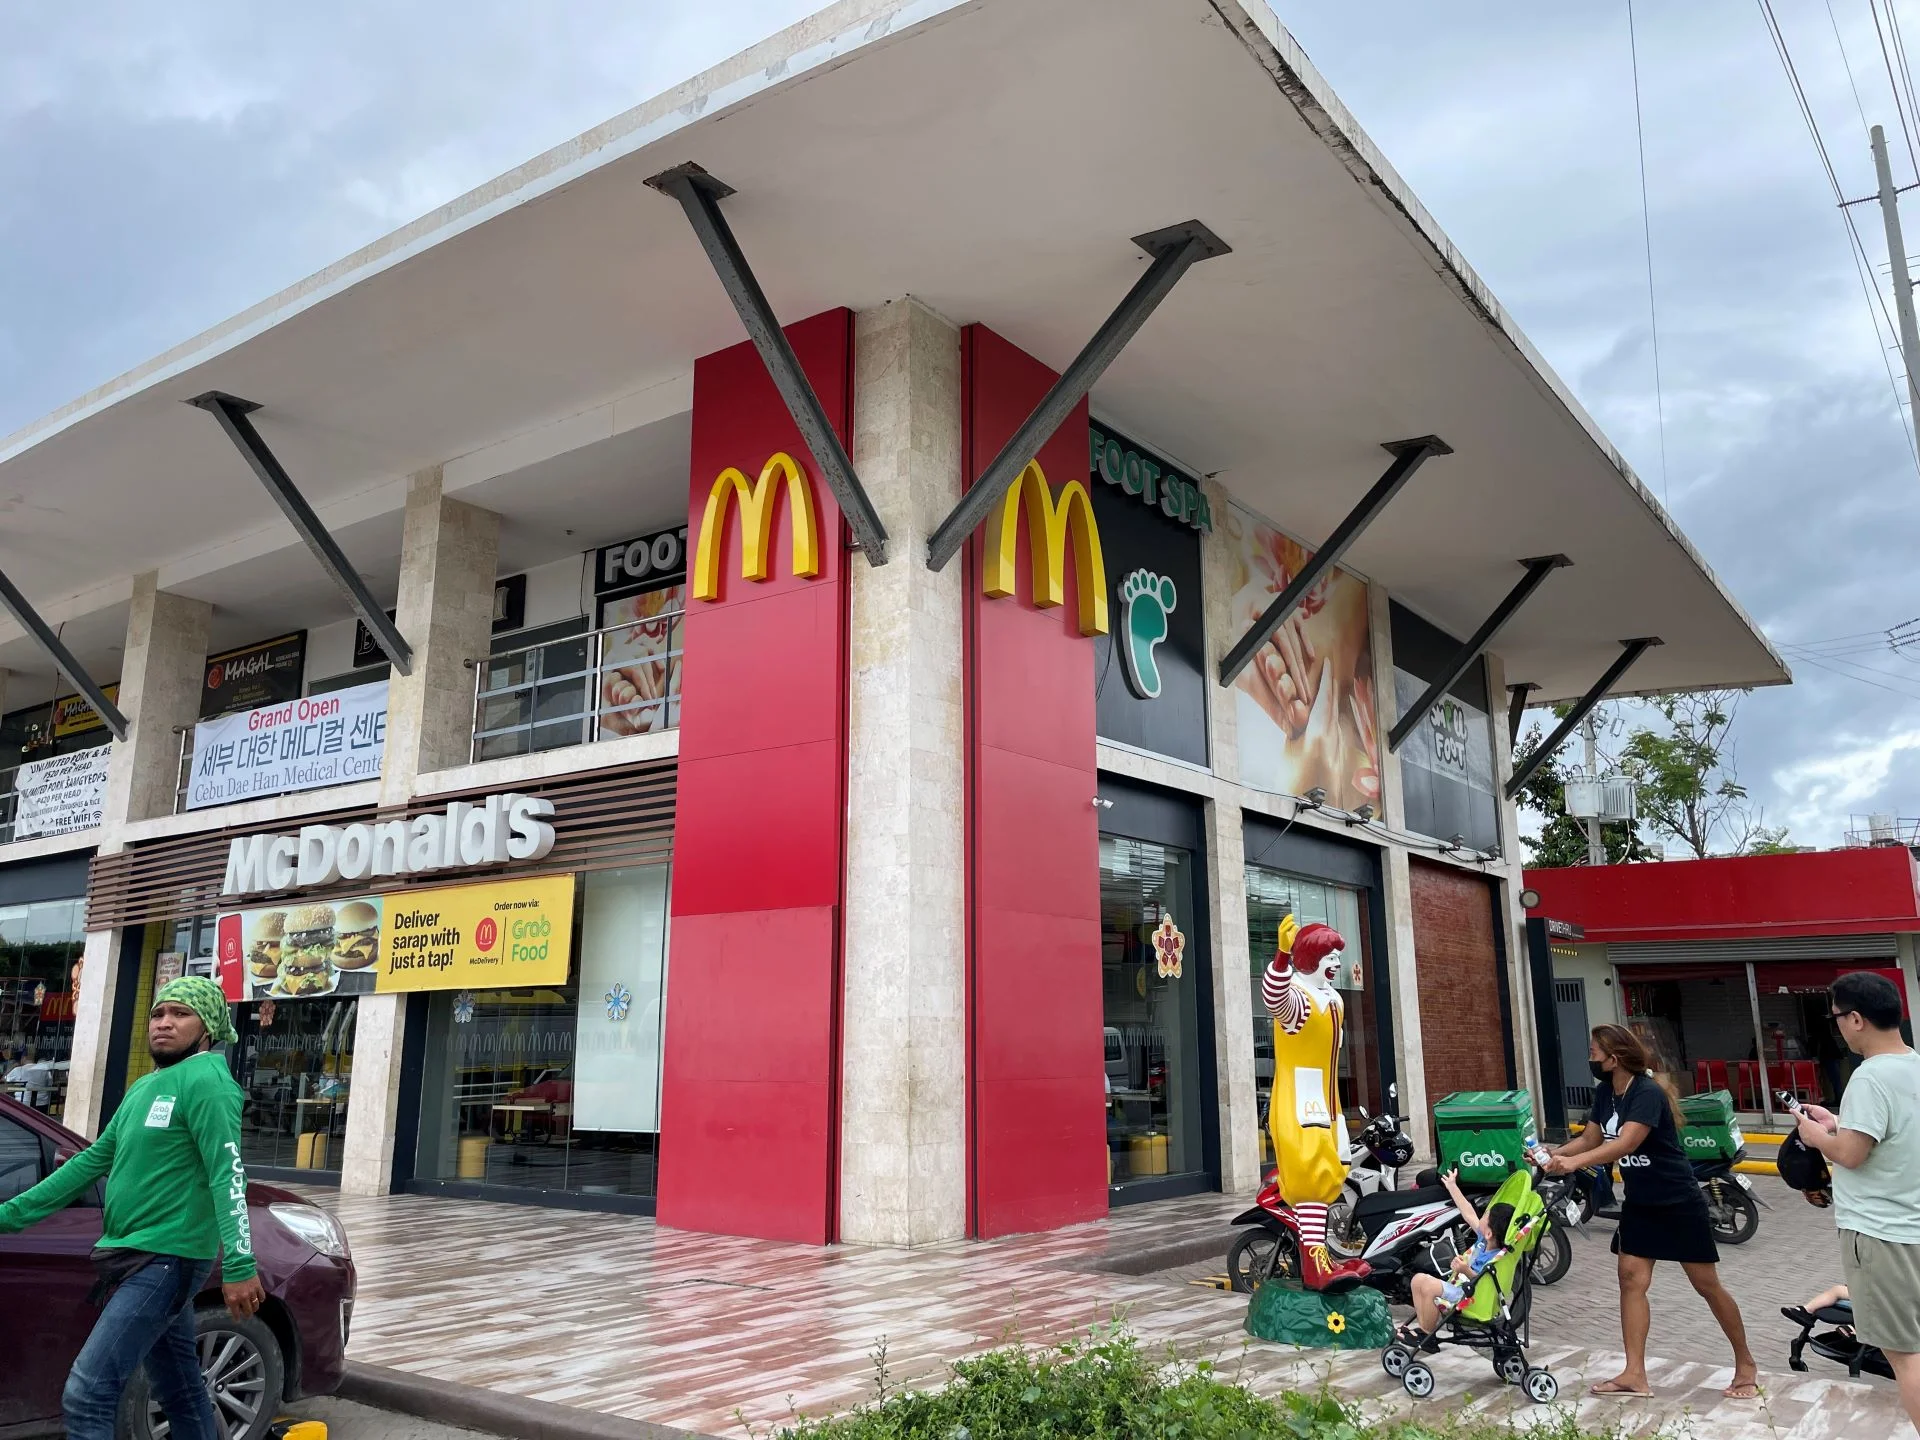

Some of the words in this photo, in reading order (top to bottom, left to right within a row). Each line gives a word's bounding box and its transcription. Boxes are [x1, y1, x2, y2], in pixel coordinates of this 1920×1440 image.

[1089, 427, 1160, 505] FOOT
[1161, 474, 1213, 536] SPA
[225, 651, 275, 680] MAGAL
[248, 703, 293, 732] Grand
[297, 698, 340, 724] Open
[199, 740, 235, 777] 세부
[237, 731, 277, 769] 대한
[280, 717, 345, 761] 메디컬
[1434, 729, 1465, 770] FOOT
[30, 756, 70, 774] UNLIMITED
[70, 752, 90, 764] PORK
[195, 783, 223, 802] Cebu
[227, 778, 249, 796] Dae
[252, 771, 279, 792] Han
[283, 758, 338, 786] Medical
[343, 753, 383, 777] Cente
[55, 817, 71, 827] FREE
[73, 813, 91, 824] WIFI
[222, 792, 556, 896] McDonald's
[494, 901, 513, 911] Order
[513, 902, 527, 910] now
[528, 899, 540, 908] via:
[394, 910, 440, 930] Deliver
[511, 914, 551, 940] Grab
[392, 931, 428, 952] sarap
[431, 927, 460, 947] with
[512, 940, 548, 962] Food
[389, 952, 416, 975] just
[417, 954, 425, 968] a
[427, 949, 454, 971] tap!
[469, 956, 499, 965] McDelivery
[149, 1113, 168, 1121] Food
[153, 1104, 170, 1113] Grab
[1683, 1135, 1717, 1149] Grab
[1459, 1150, 1505, 1168] Grab
[1619, 1155, 1650, 1167] das
[224, 1141, 251, 1255] GrabFood
